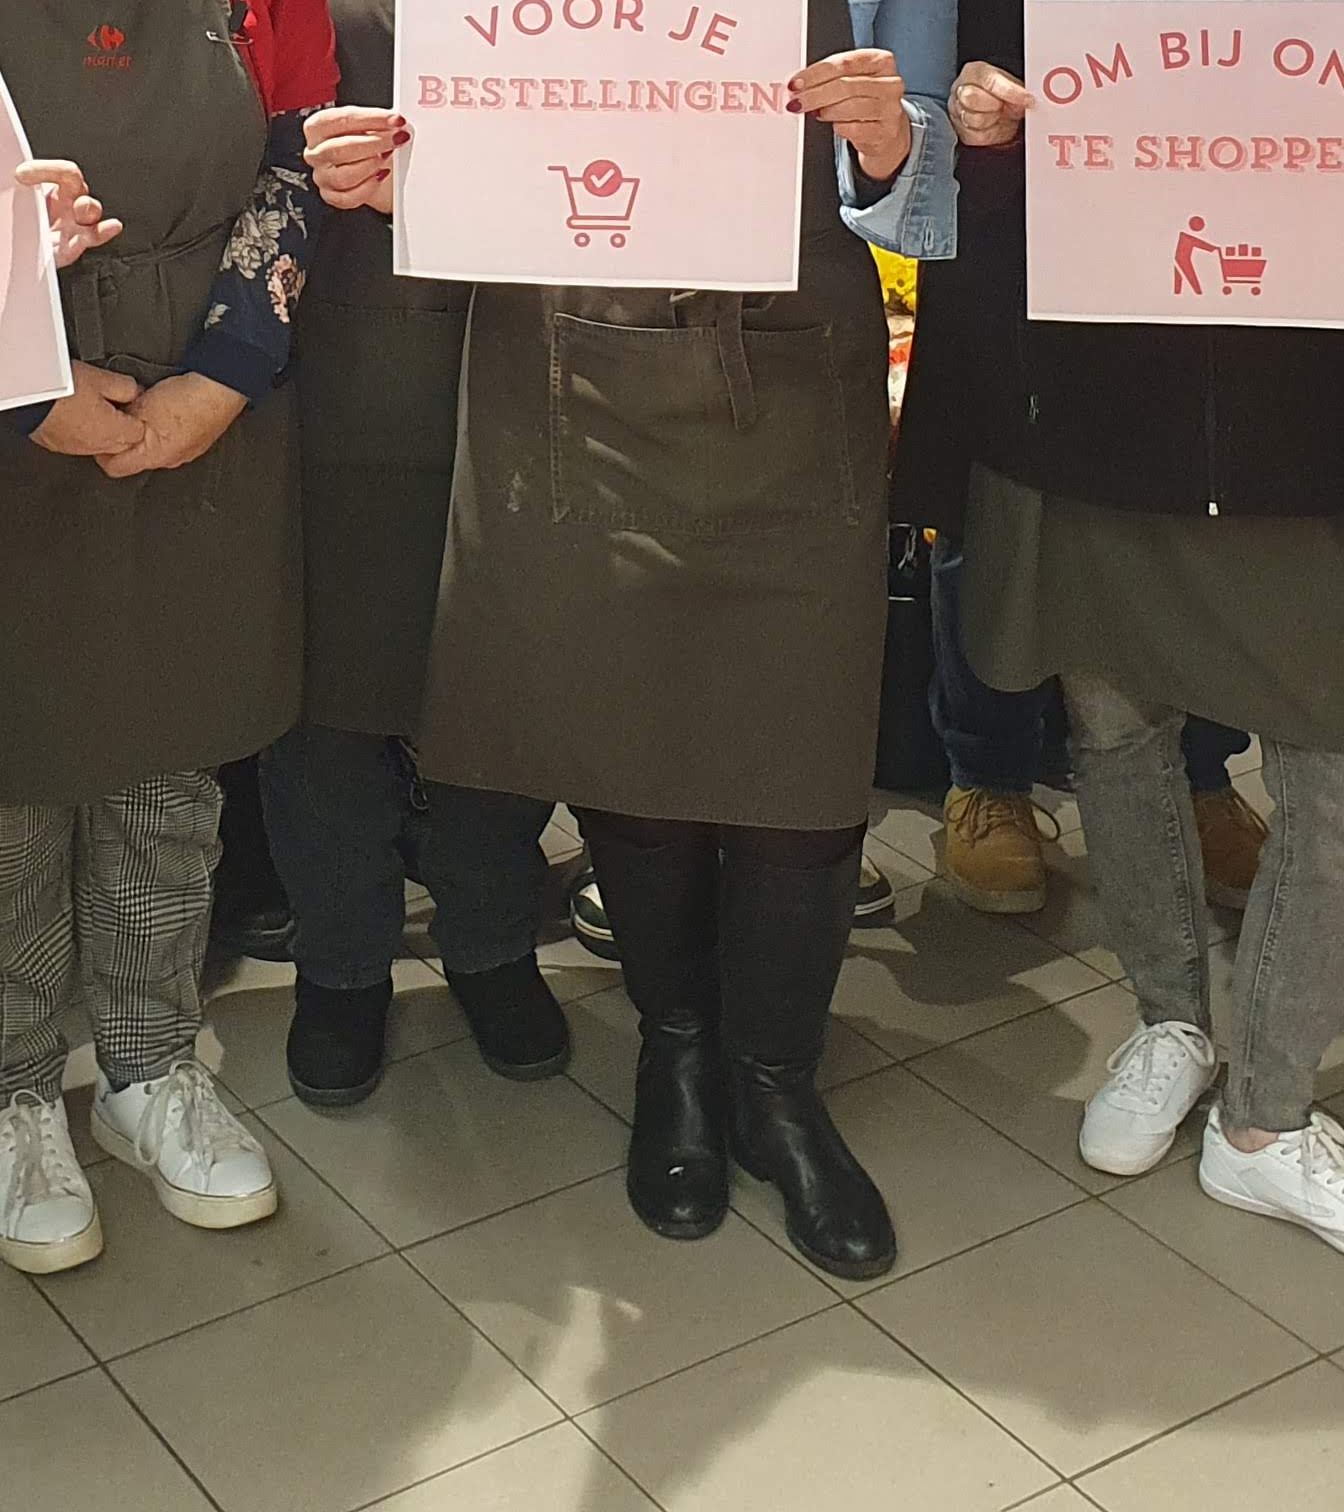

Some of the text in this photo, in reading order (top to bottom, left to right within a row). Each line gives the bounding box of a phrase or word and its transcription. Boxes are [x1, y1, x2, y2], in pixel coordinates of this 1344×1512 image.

[667, 5, 738, 56] JE
[1042, 42, 1134, 105] OM
[1159, 29, 1242, 70] BIJ
[417, 75, 784, 114] BESTELLINGEN
[1048, 134, 1114, 171] TE
